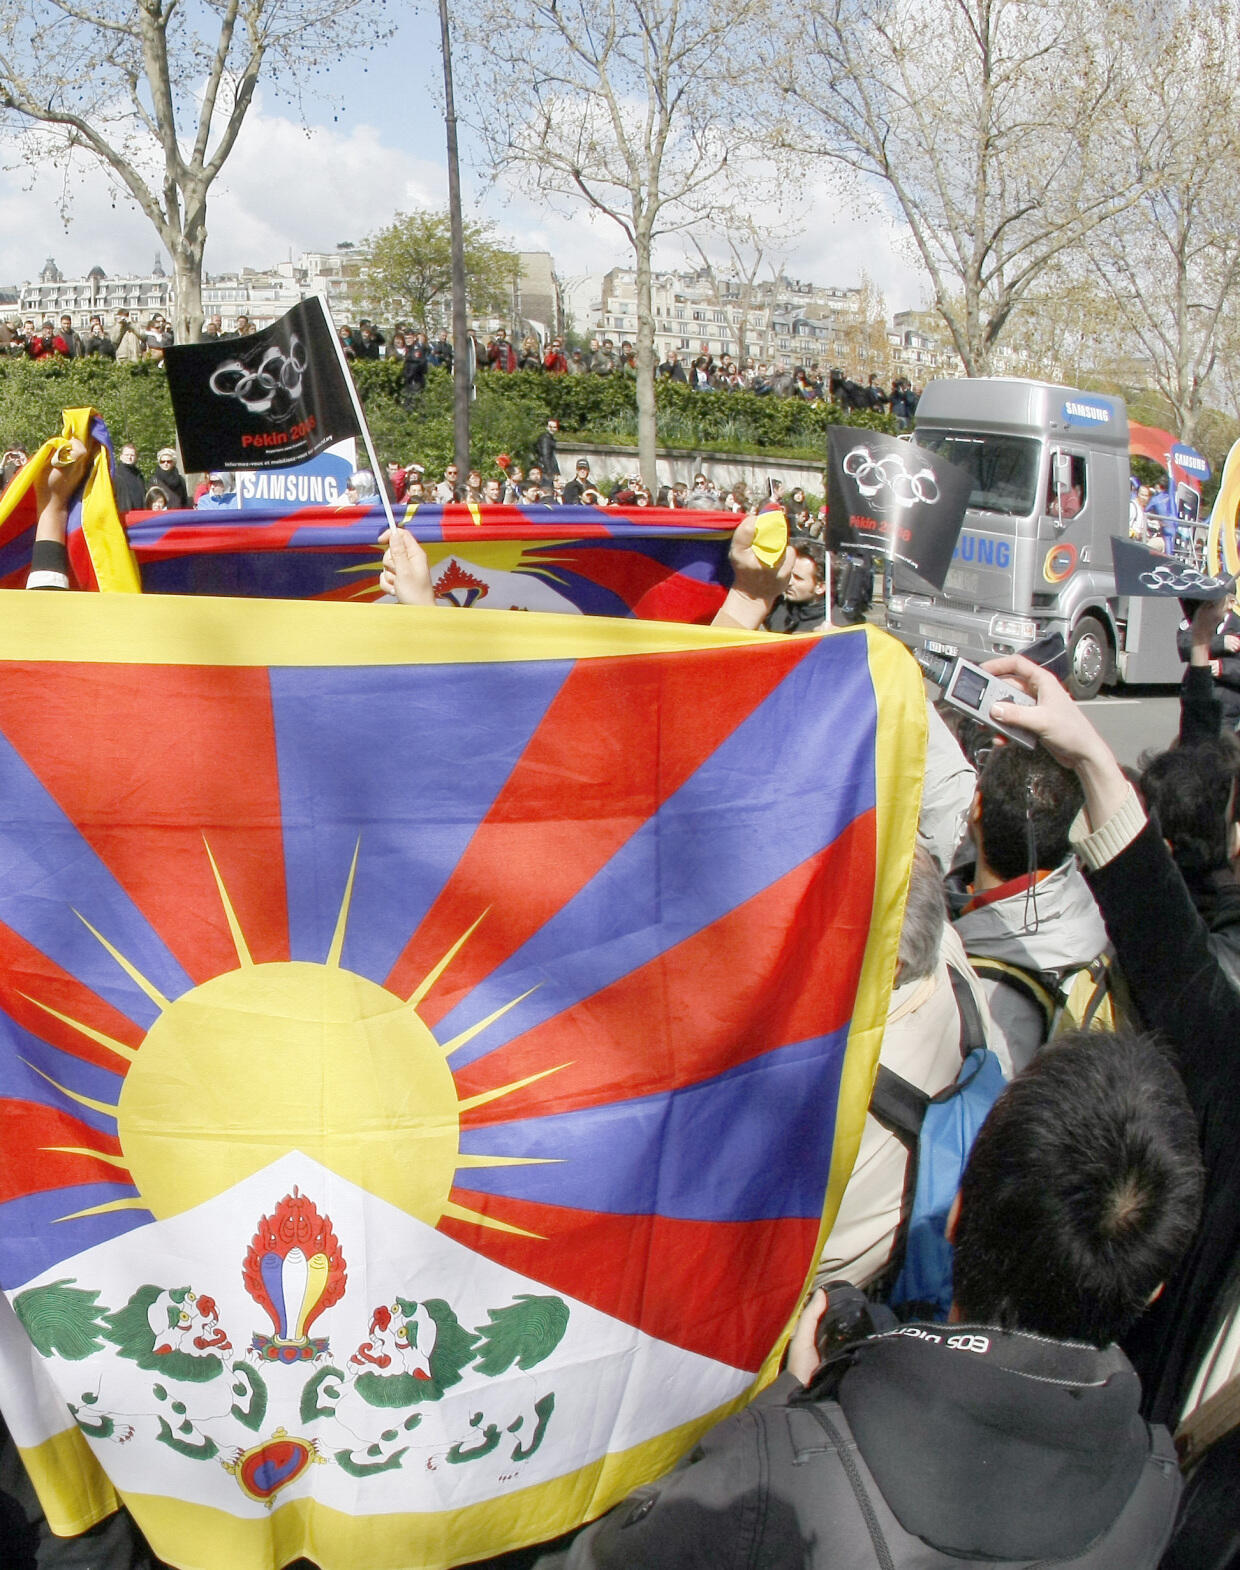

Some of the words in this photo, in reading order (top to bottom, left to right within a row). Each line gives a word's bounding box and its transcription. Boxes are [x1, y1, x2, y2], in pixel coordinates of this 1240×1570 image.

[1065, 401, 1110, 423] SAMSUNG
[241, 432, 288, 448] Pékin
[1174, 452, 1206, 471] SAMSUNG
[243, 474, 339, 503] SAMSUNG
[944, 1334, 990, 1354] EOS
